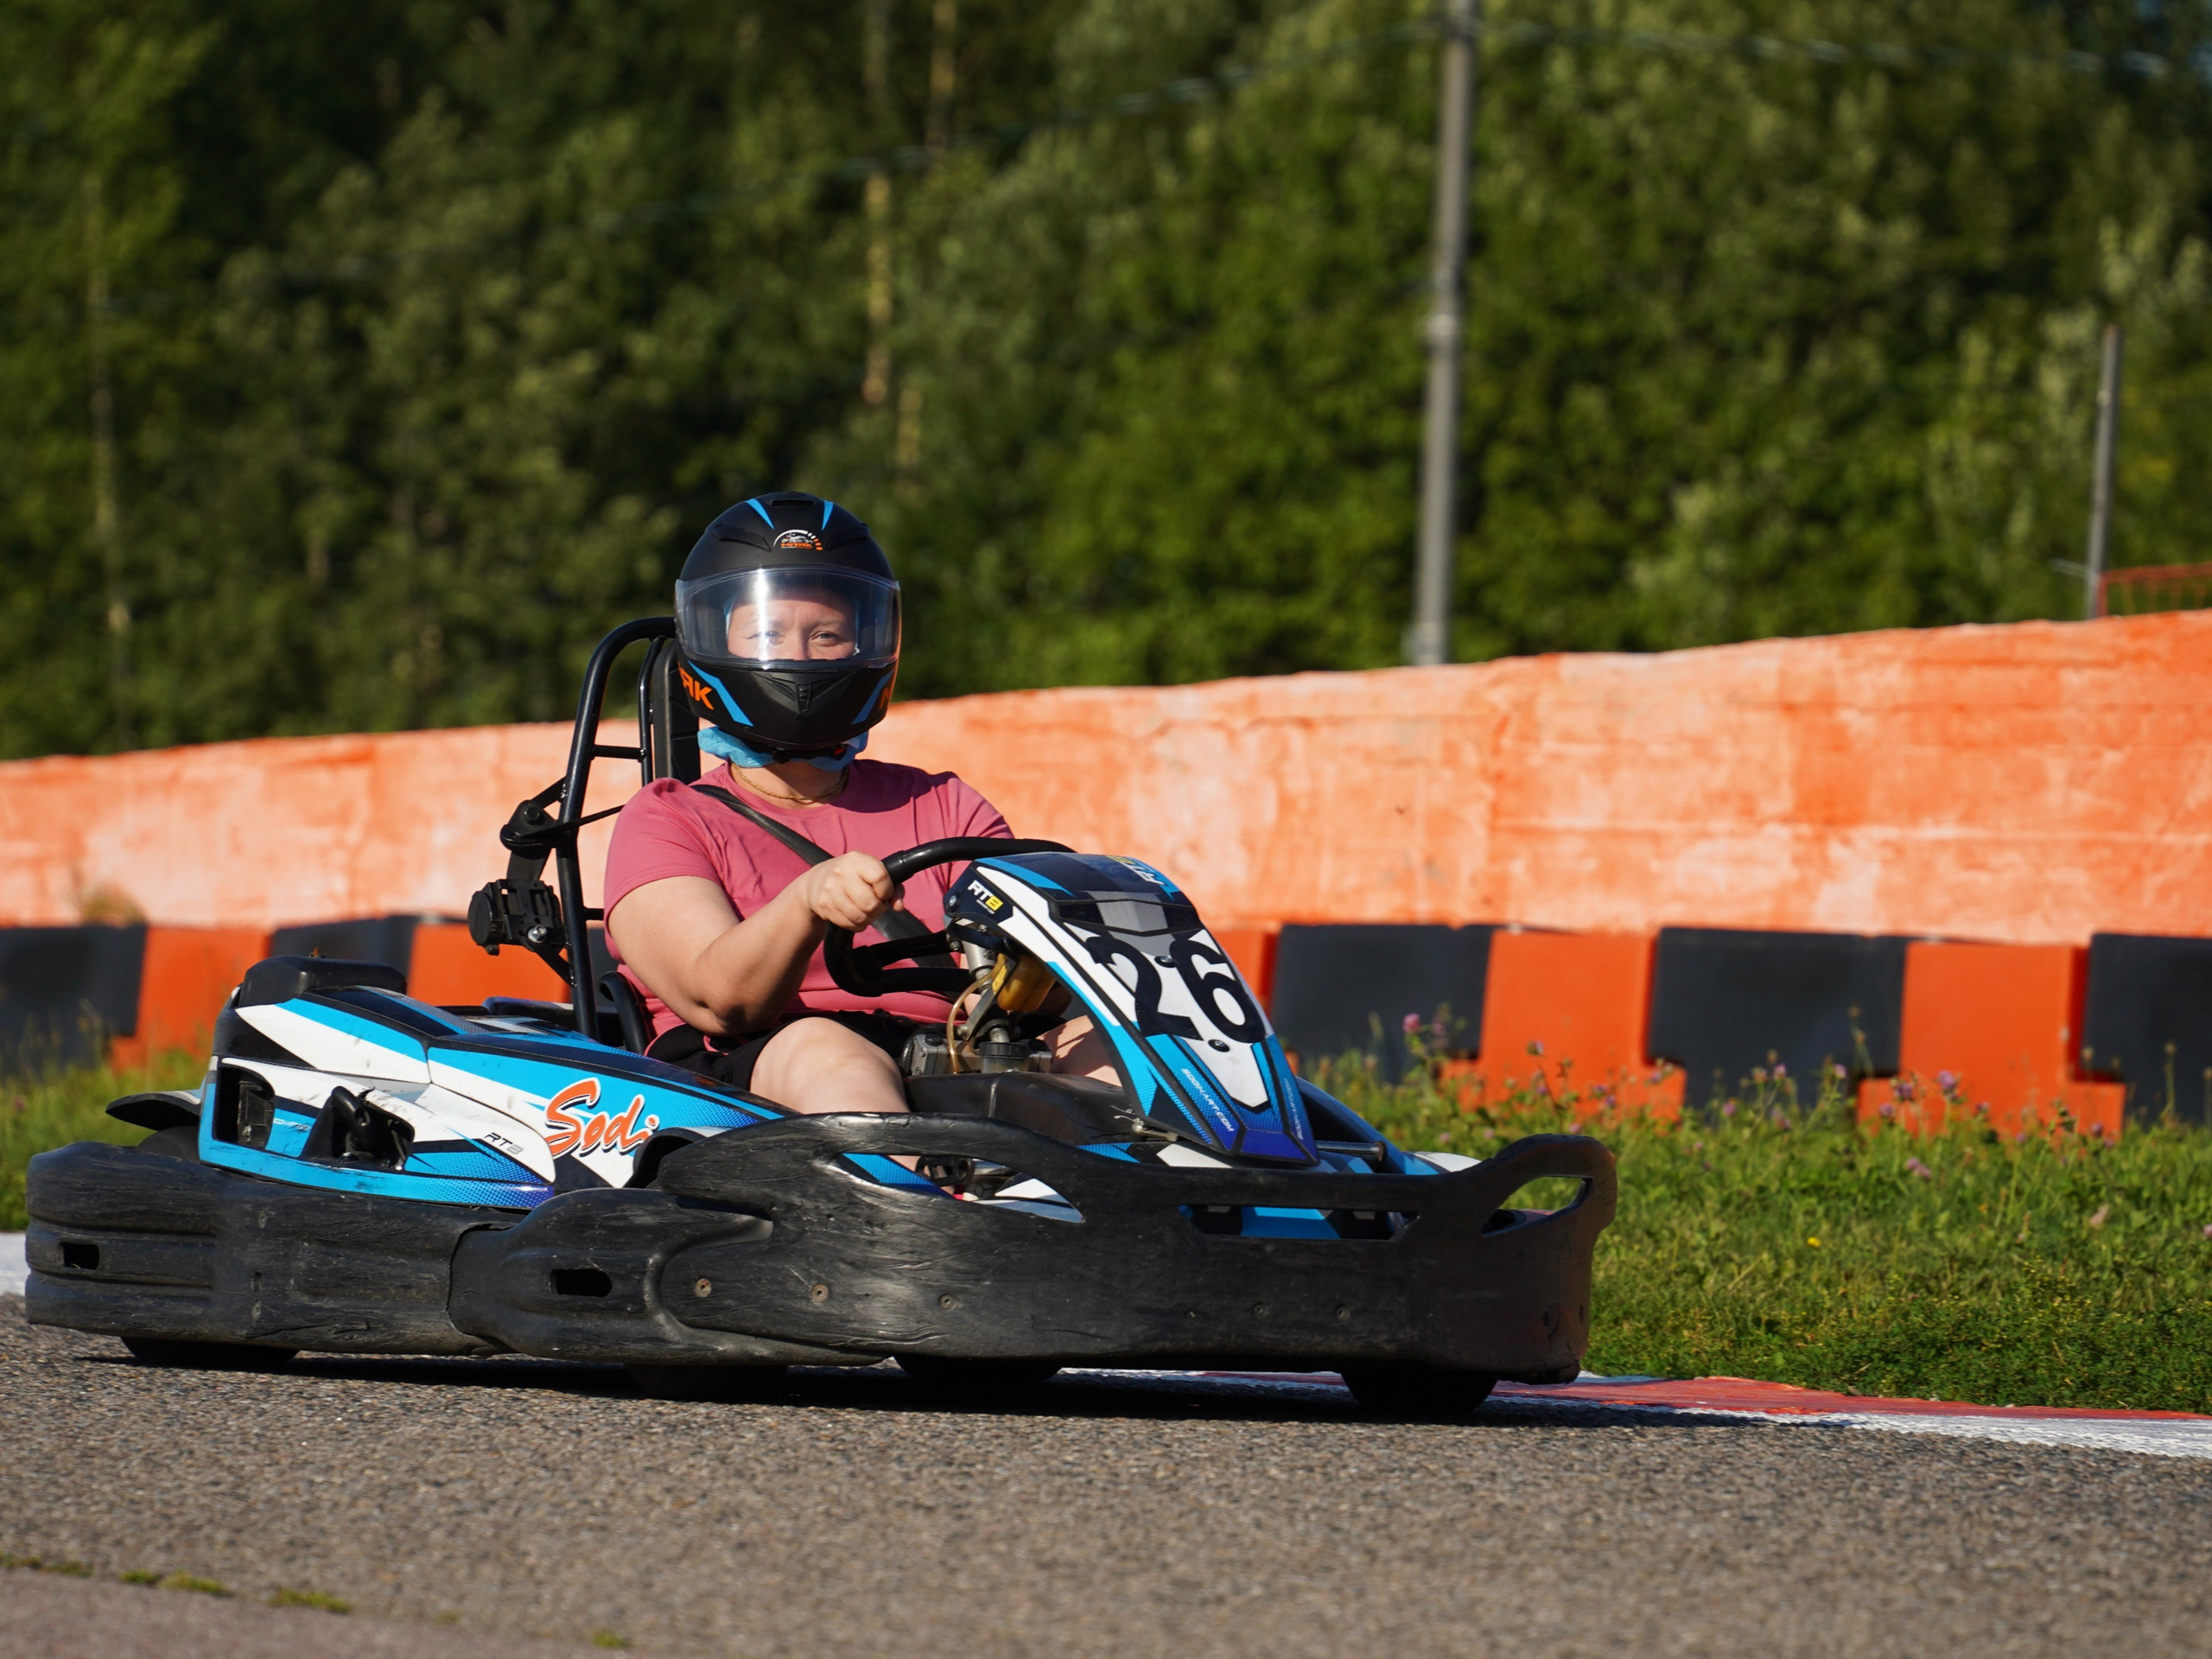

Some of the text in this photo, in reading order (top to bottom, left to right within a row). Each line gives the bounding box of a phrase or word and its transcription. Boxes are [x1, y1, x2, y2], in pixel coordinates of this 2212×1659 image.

[967, 880, 1004, 911] RT8
[1085, 936, 1267, 1044] 26
[484, 1132, 524, 1154] RT8
[544, 1077, 660, 1159] Sodi
